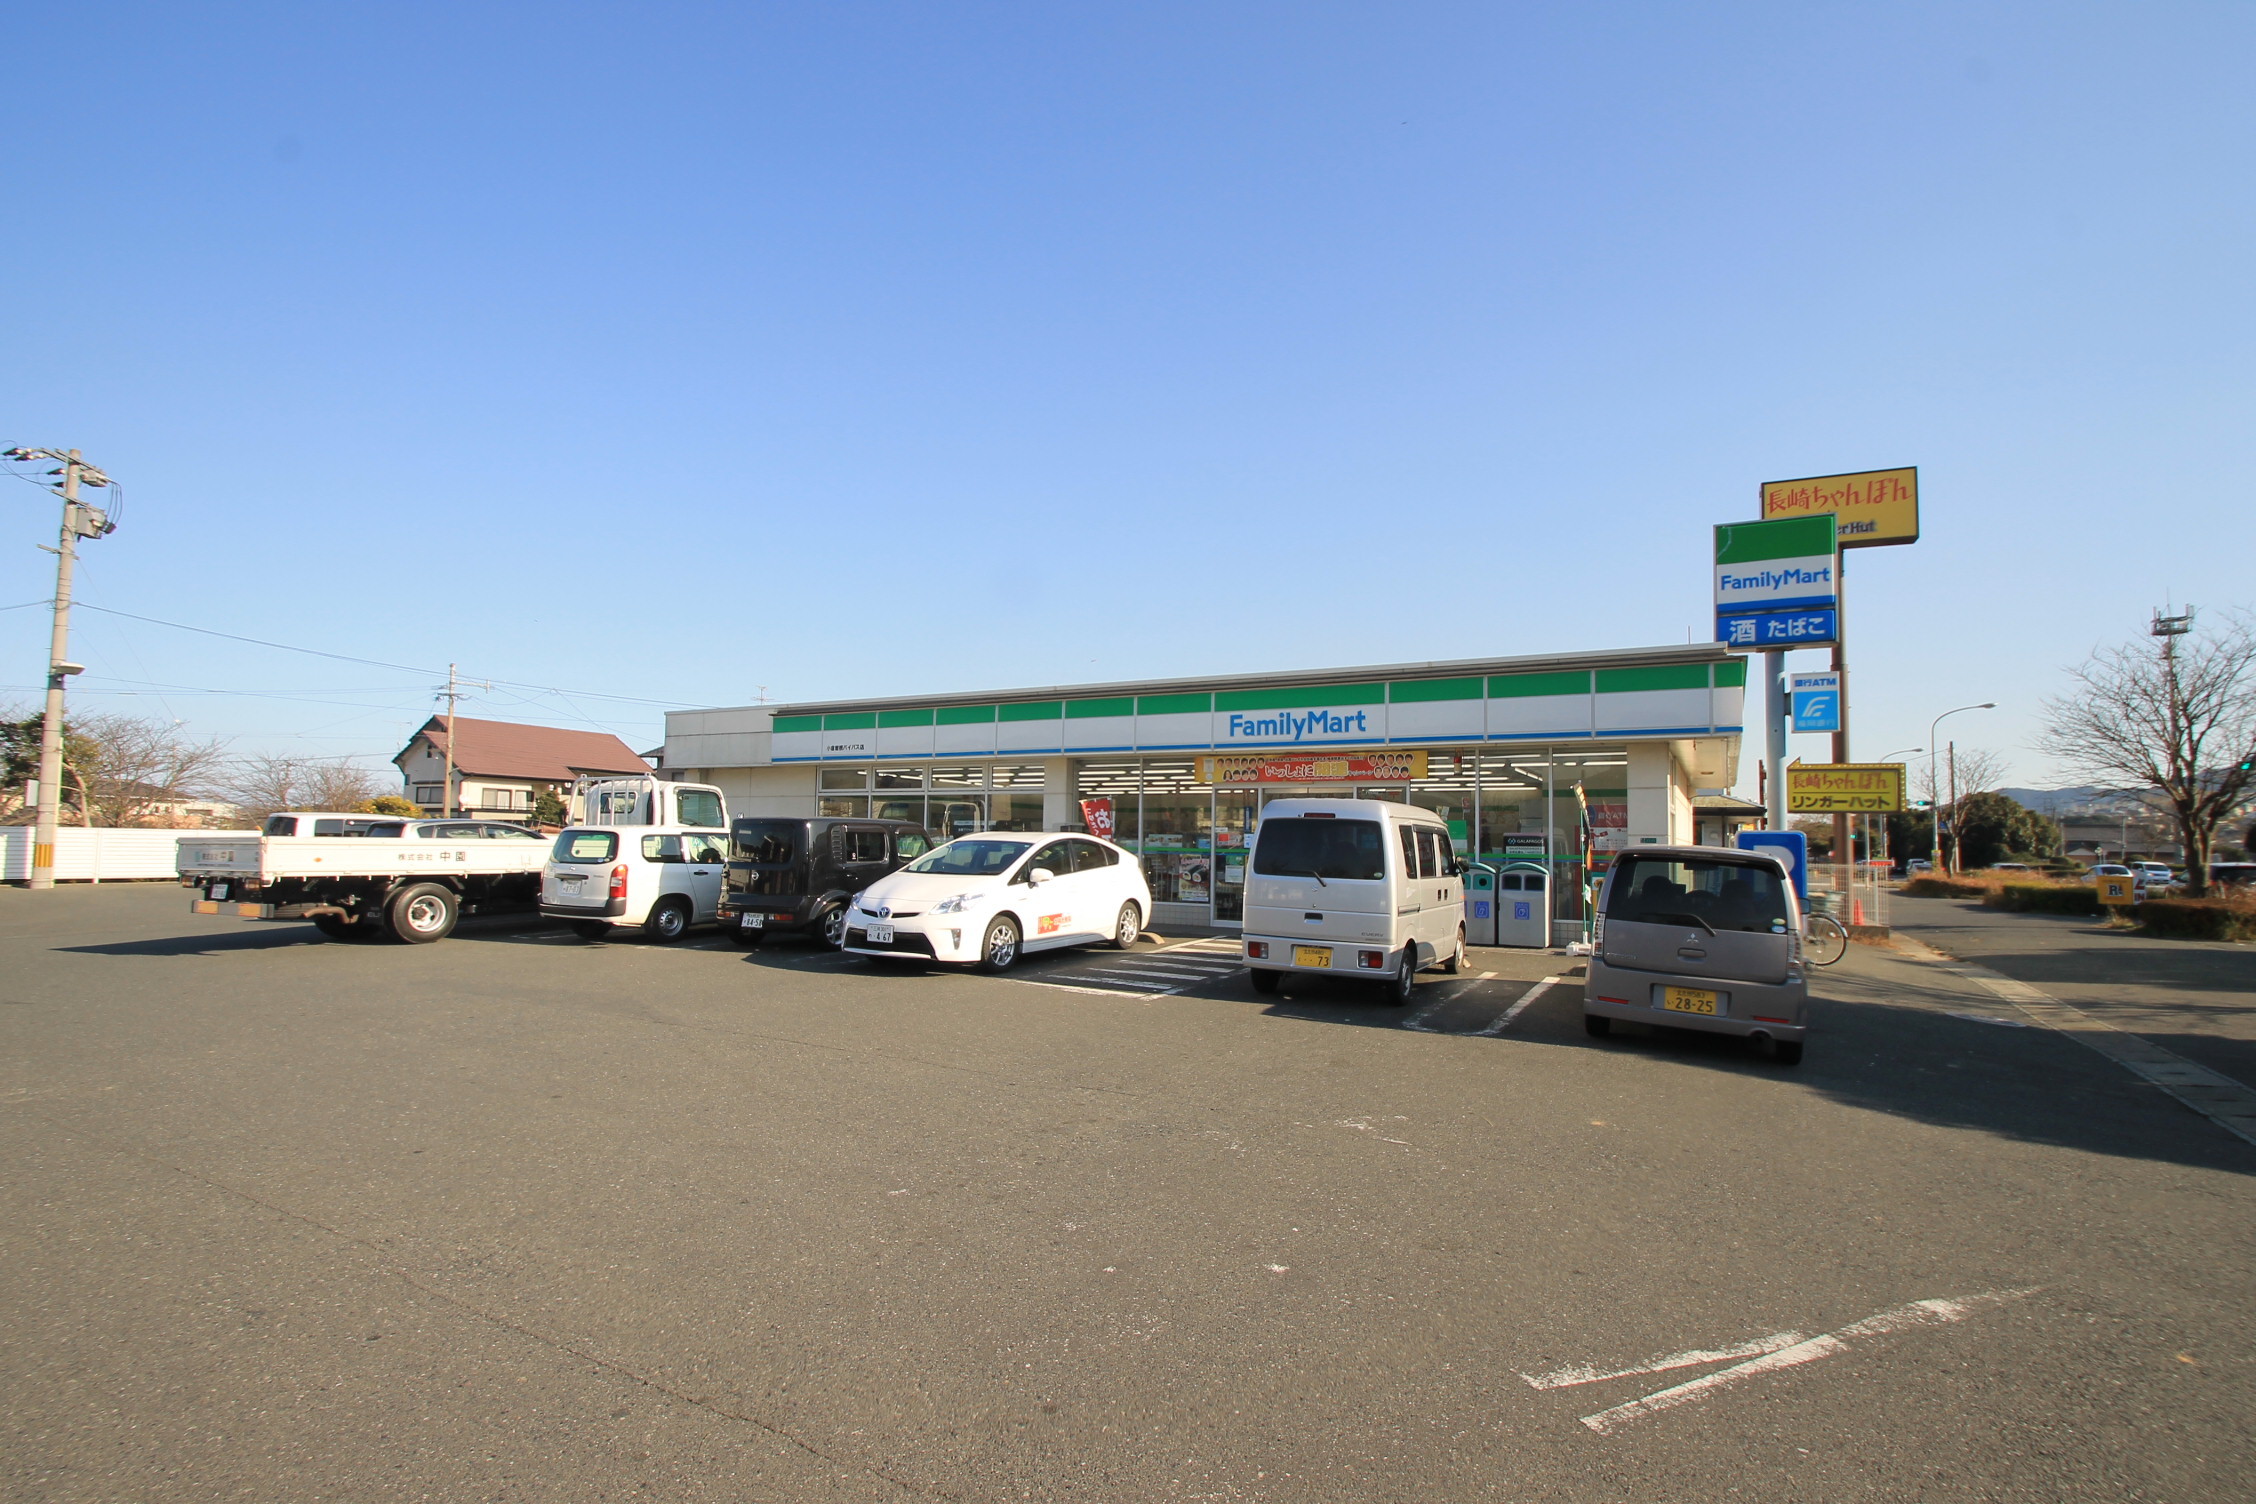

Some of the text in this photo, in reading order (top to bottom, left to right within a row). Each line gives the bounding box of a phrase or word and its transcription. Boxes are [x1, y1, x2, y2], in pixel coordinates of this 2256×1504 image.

[1767, 478, 1912, 513] 長崎ちゃんぽん
[1850, 519, 1877, 534] Hut
[1721, 567, 1830, 590] FamilyMart
[1729, 617, 1826, 642] 酒 たばこ
[1229, 709, 1366, 740] FamilyMart
[1793, 771, 1889, 790] 長崎ちゃんぽん
[1792, 795, 1890, 809] リンガーハット
[1675, 996, 1713, 1013] 28-25
